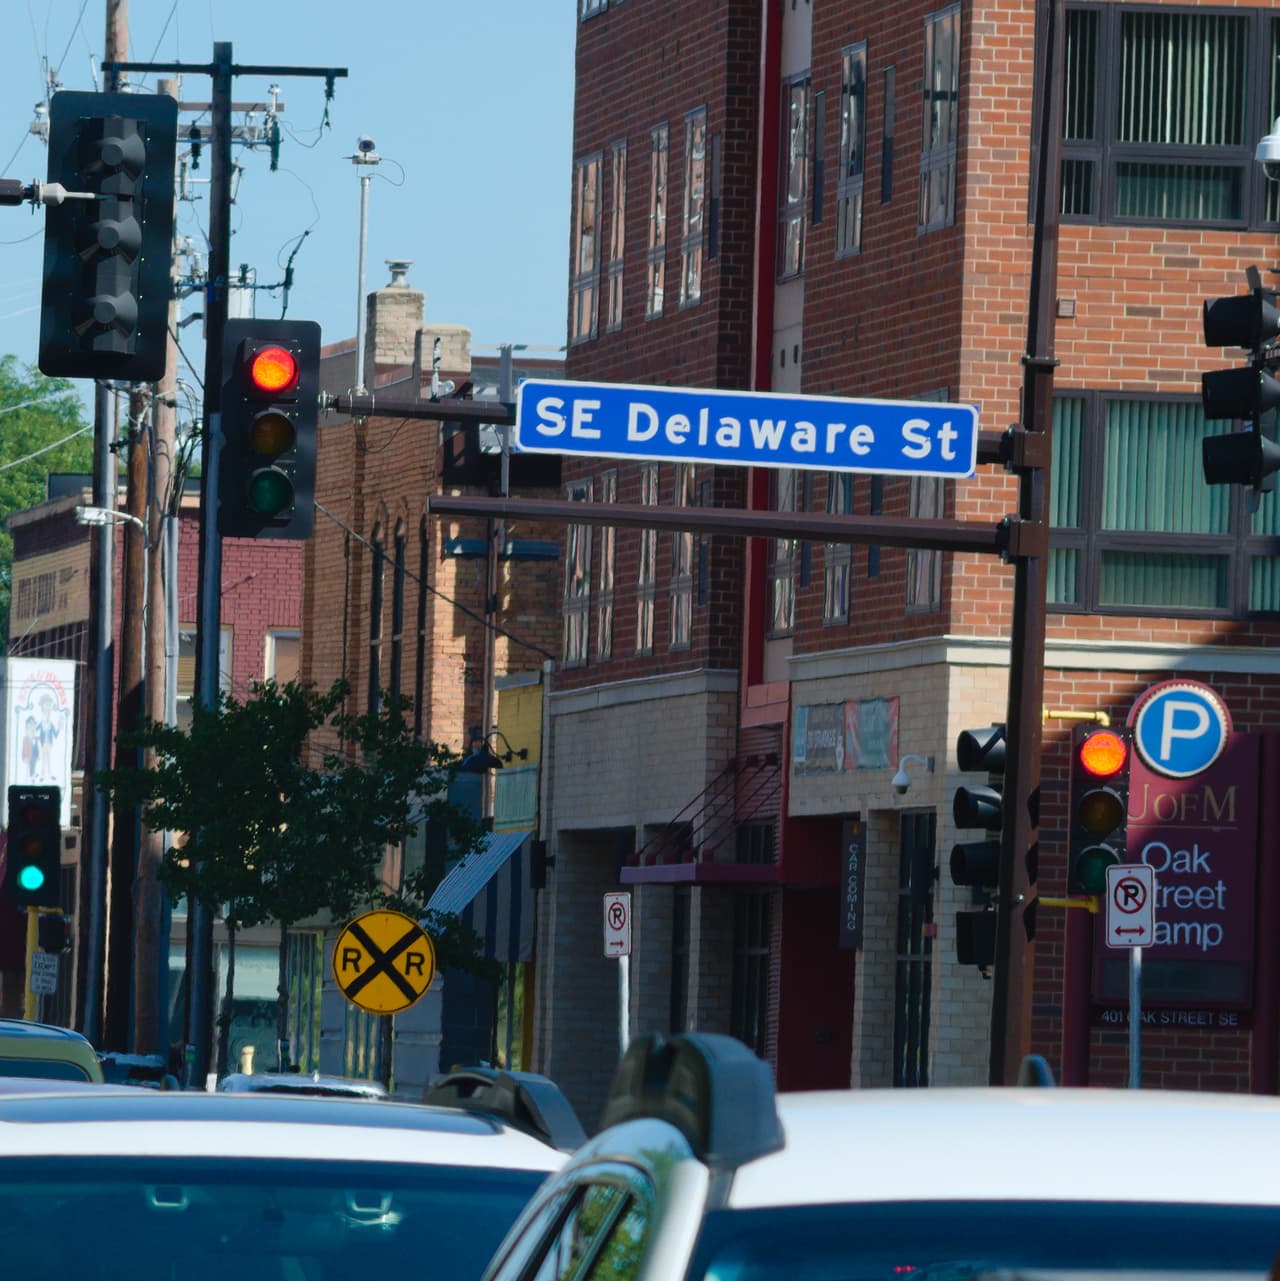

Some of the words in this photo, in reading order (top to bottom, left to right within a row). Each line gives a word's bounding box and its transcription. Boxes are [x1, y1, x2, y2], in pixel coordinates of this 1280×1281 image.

[535, 397, 602, 440] SE
[627, 402, 876, 456] Delaware
[900, 418, 958, 461] St
[1160, 699, 1210, 761] P
[848, 843, 858, 872] CAR
[1142, 841, 1212, 873] Oak
[847, 875, 858, 931] COMING
[1154, 880, 1227, 910] treet
[1154, 920, 1224, 952] amp
[1102, 1009, 1124, 1023] 401
[1161, 1011, 1214, 1026] STREET
[1219, 1013, 1239, 1027] SE
